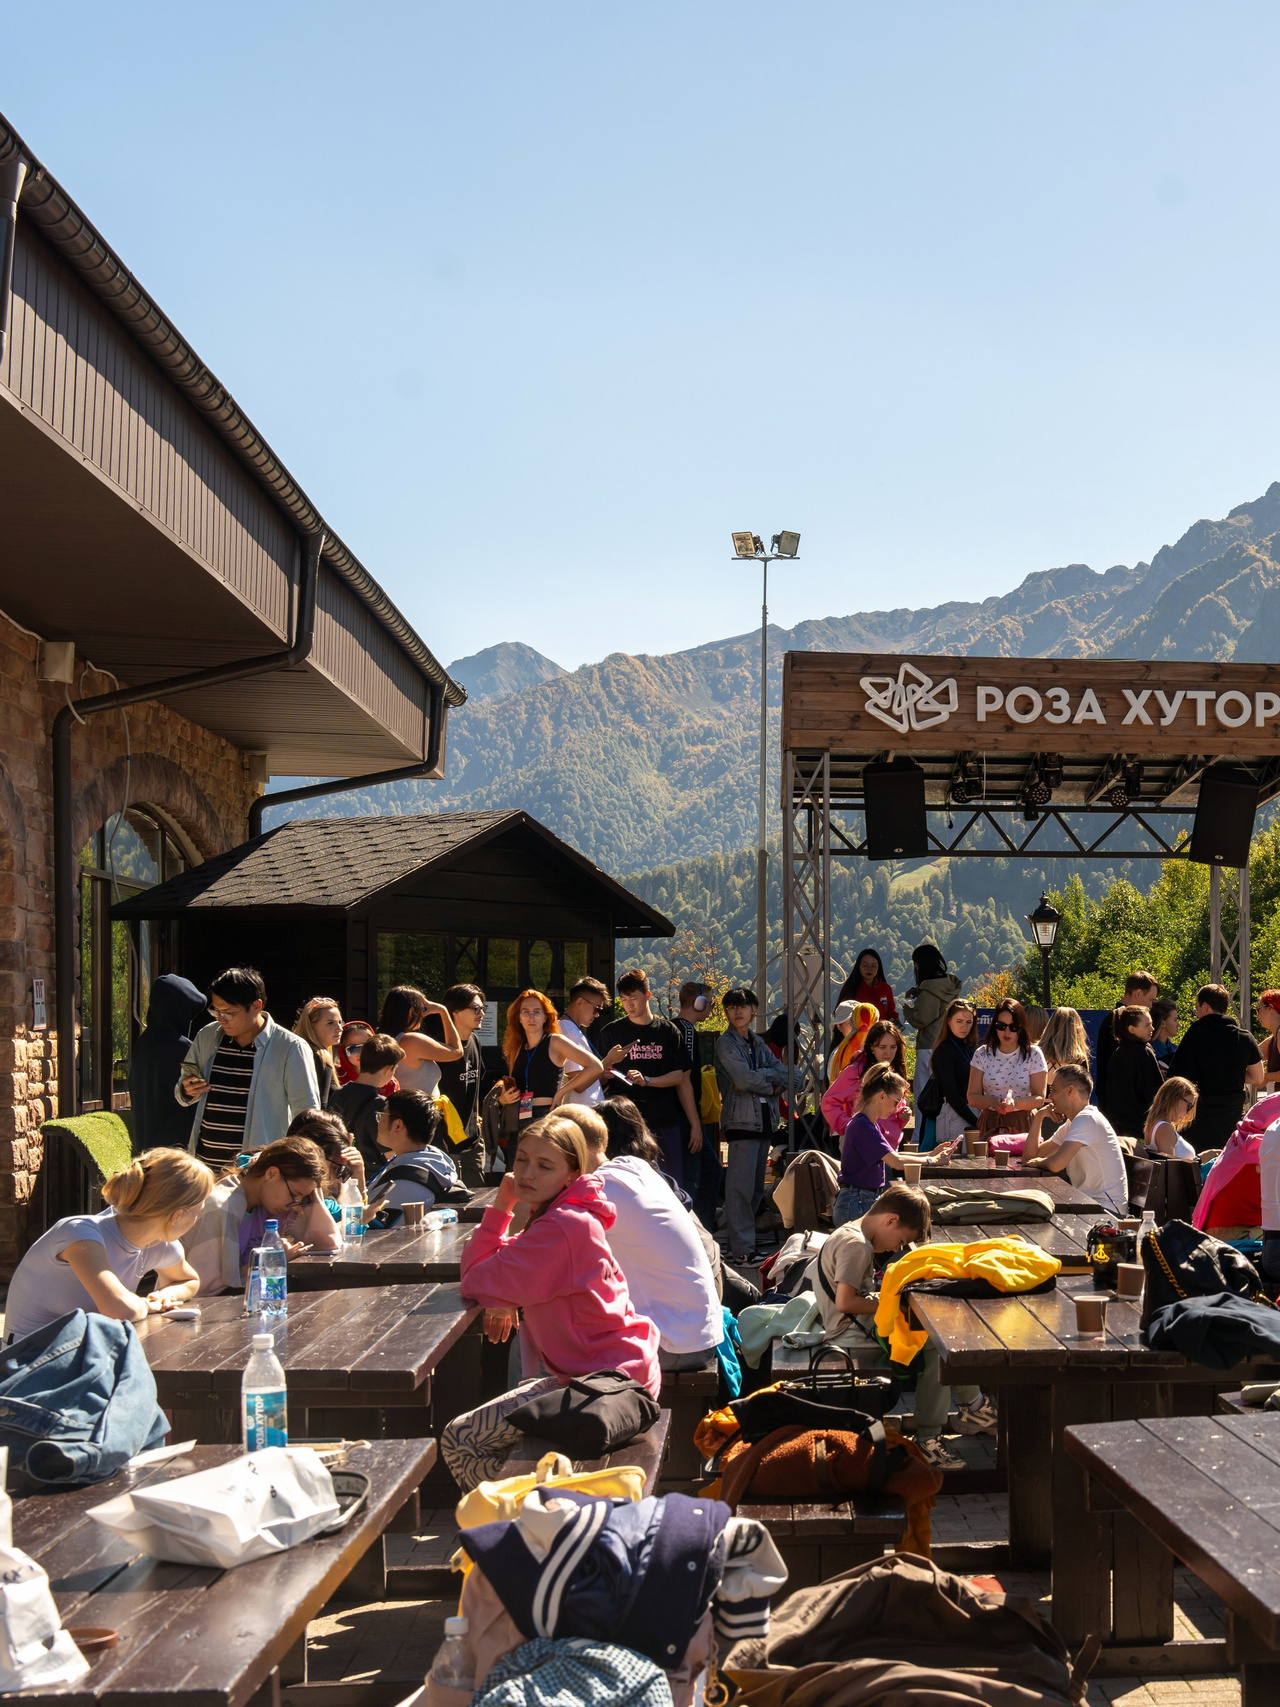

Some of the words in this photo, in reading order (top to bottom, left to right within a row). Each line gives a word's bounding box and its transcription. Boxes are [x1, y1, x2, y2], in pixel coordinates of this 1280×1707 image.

[975, 684, 1107, 725] РОЗА
[255, 1395, 264, 1425] ХУТОР
[256, 1425, 265, 1451] РОЗА
